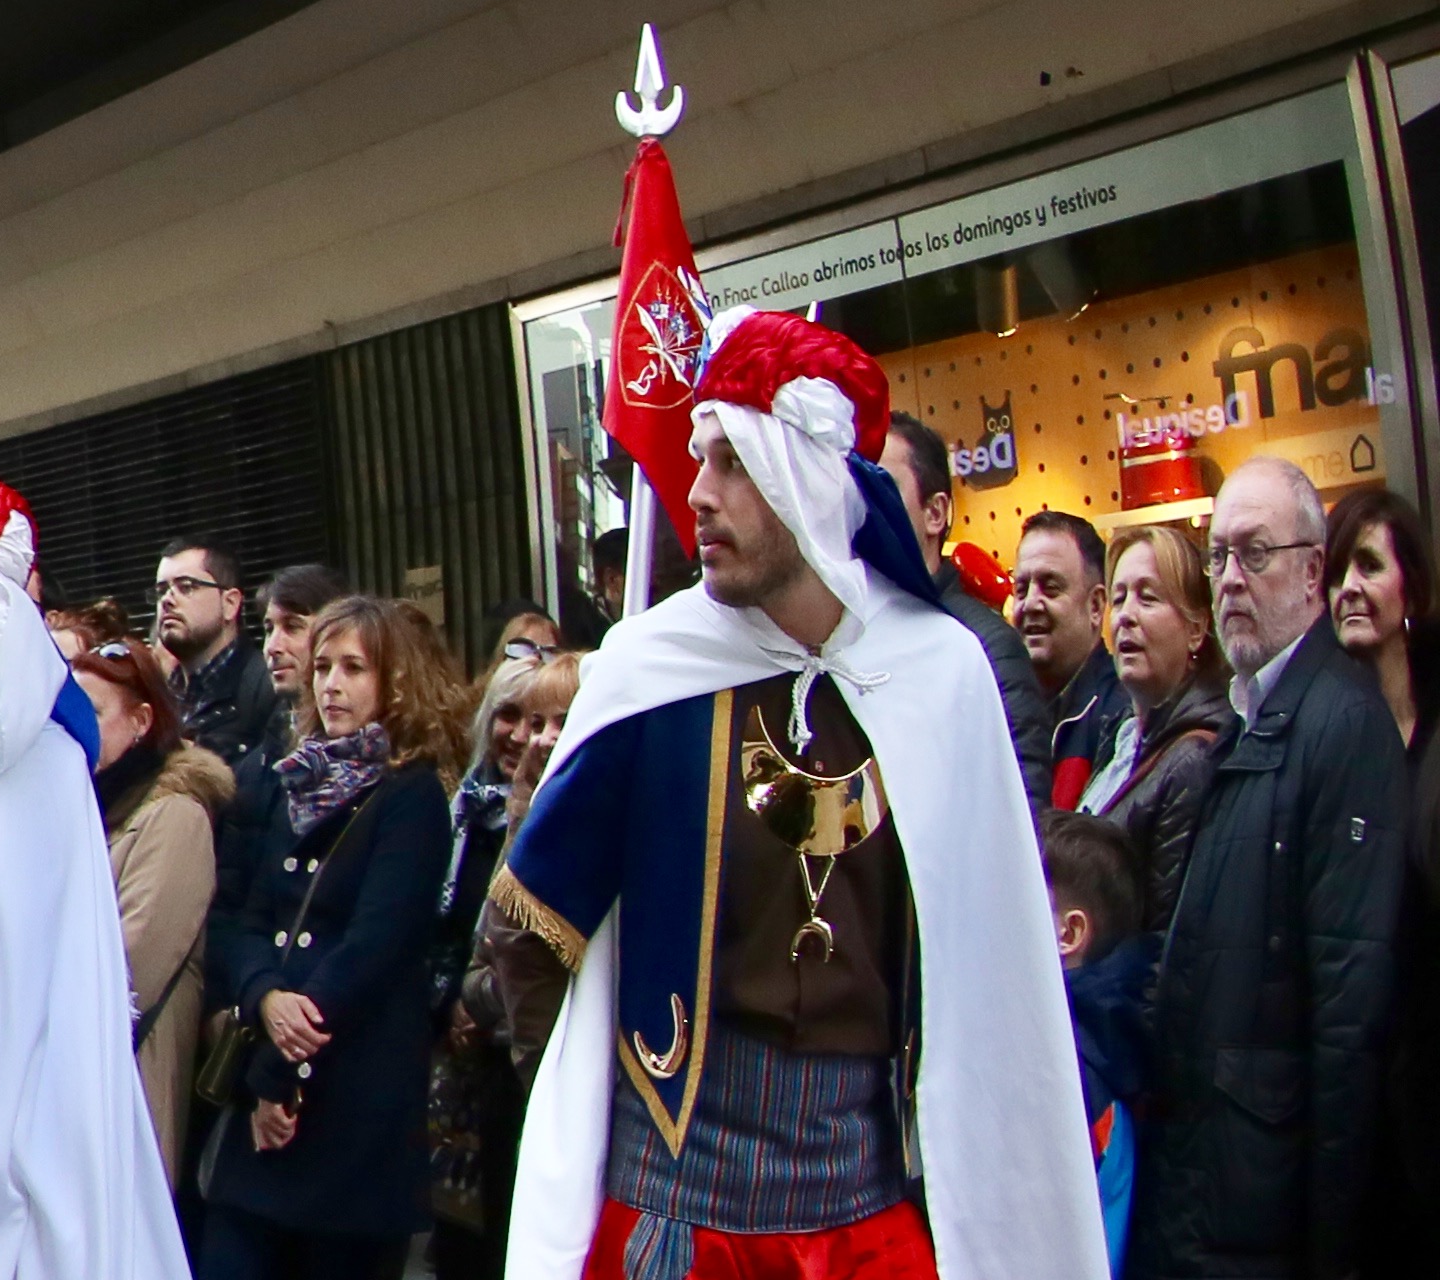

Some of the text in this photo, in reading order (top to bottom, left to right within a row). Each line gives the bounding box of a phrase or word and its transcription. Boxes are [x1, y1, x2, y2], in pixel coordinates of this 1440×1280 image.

[723, 284, 758, 306] Fnac
[761, 271, 810, 296] Callao
[813, 254, 876, 284] abrimos
[879, 239, 923, 265] todos
[926, 231, 950, 255] los
[952, 210, 1032, 245] domingos
[1035, 205, 1047, 227] y
[1050, 183, 1117, 219] festivos
